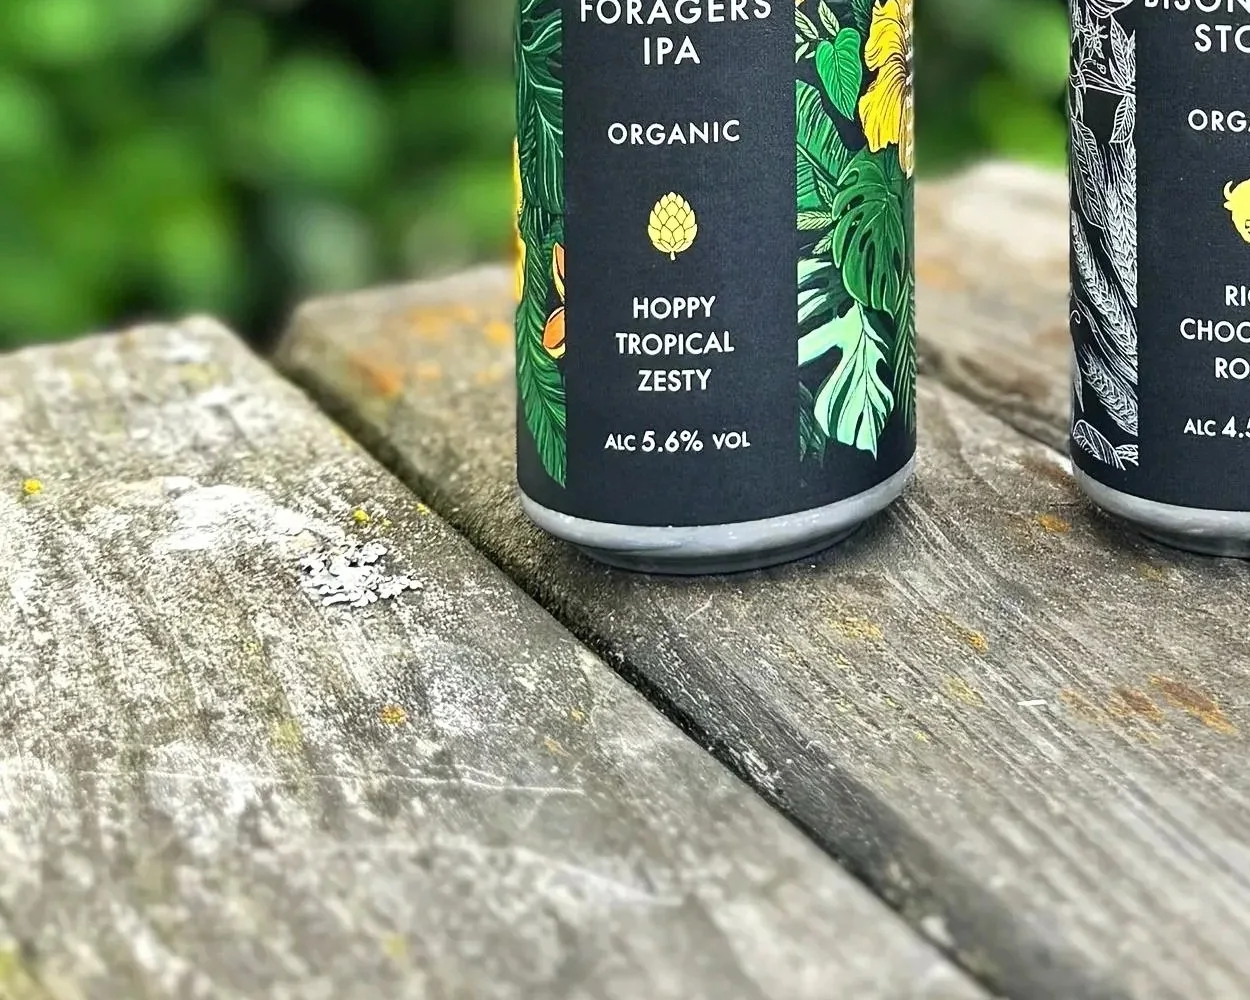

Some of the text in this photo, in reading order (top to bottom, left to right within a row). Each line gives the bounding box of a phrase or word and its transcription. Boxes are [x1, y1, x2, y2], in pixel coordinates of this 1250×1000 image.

[643, 35, 701, 66] IPA
[607, 119, 740, 146] ORGANIC
[632, 295, 716, 320] HOPPY
[615, 330, 735, 356] TROPICAL
[637, 368, 712, 392] ZESTY
[1183, 418, 1217, 437] ALC
[604, 429, 751, 453] ALC 5.6% VOL
